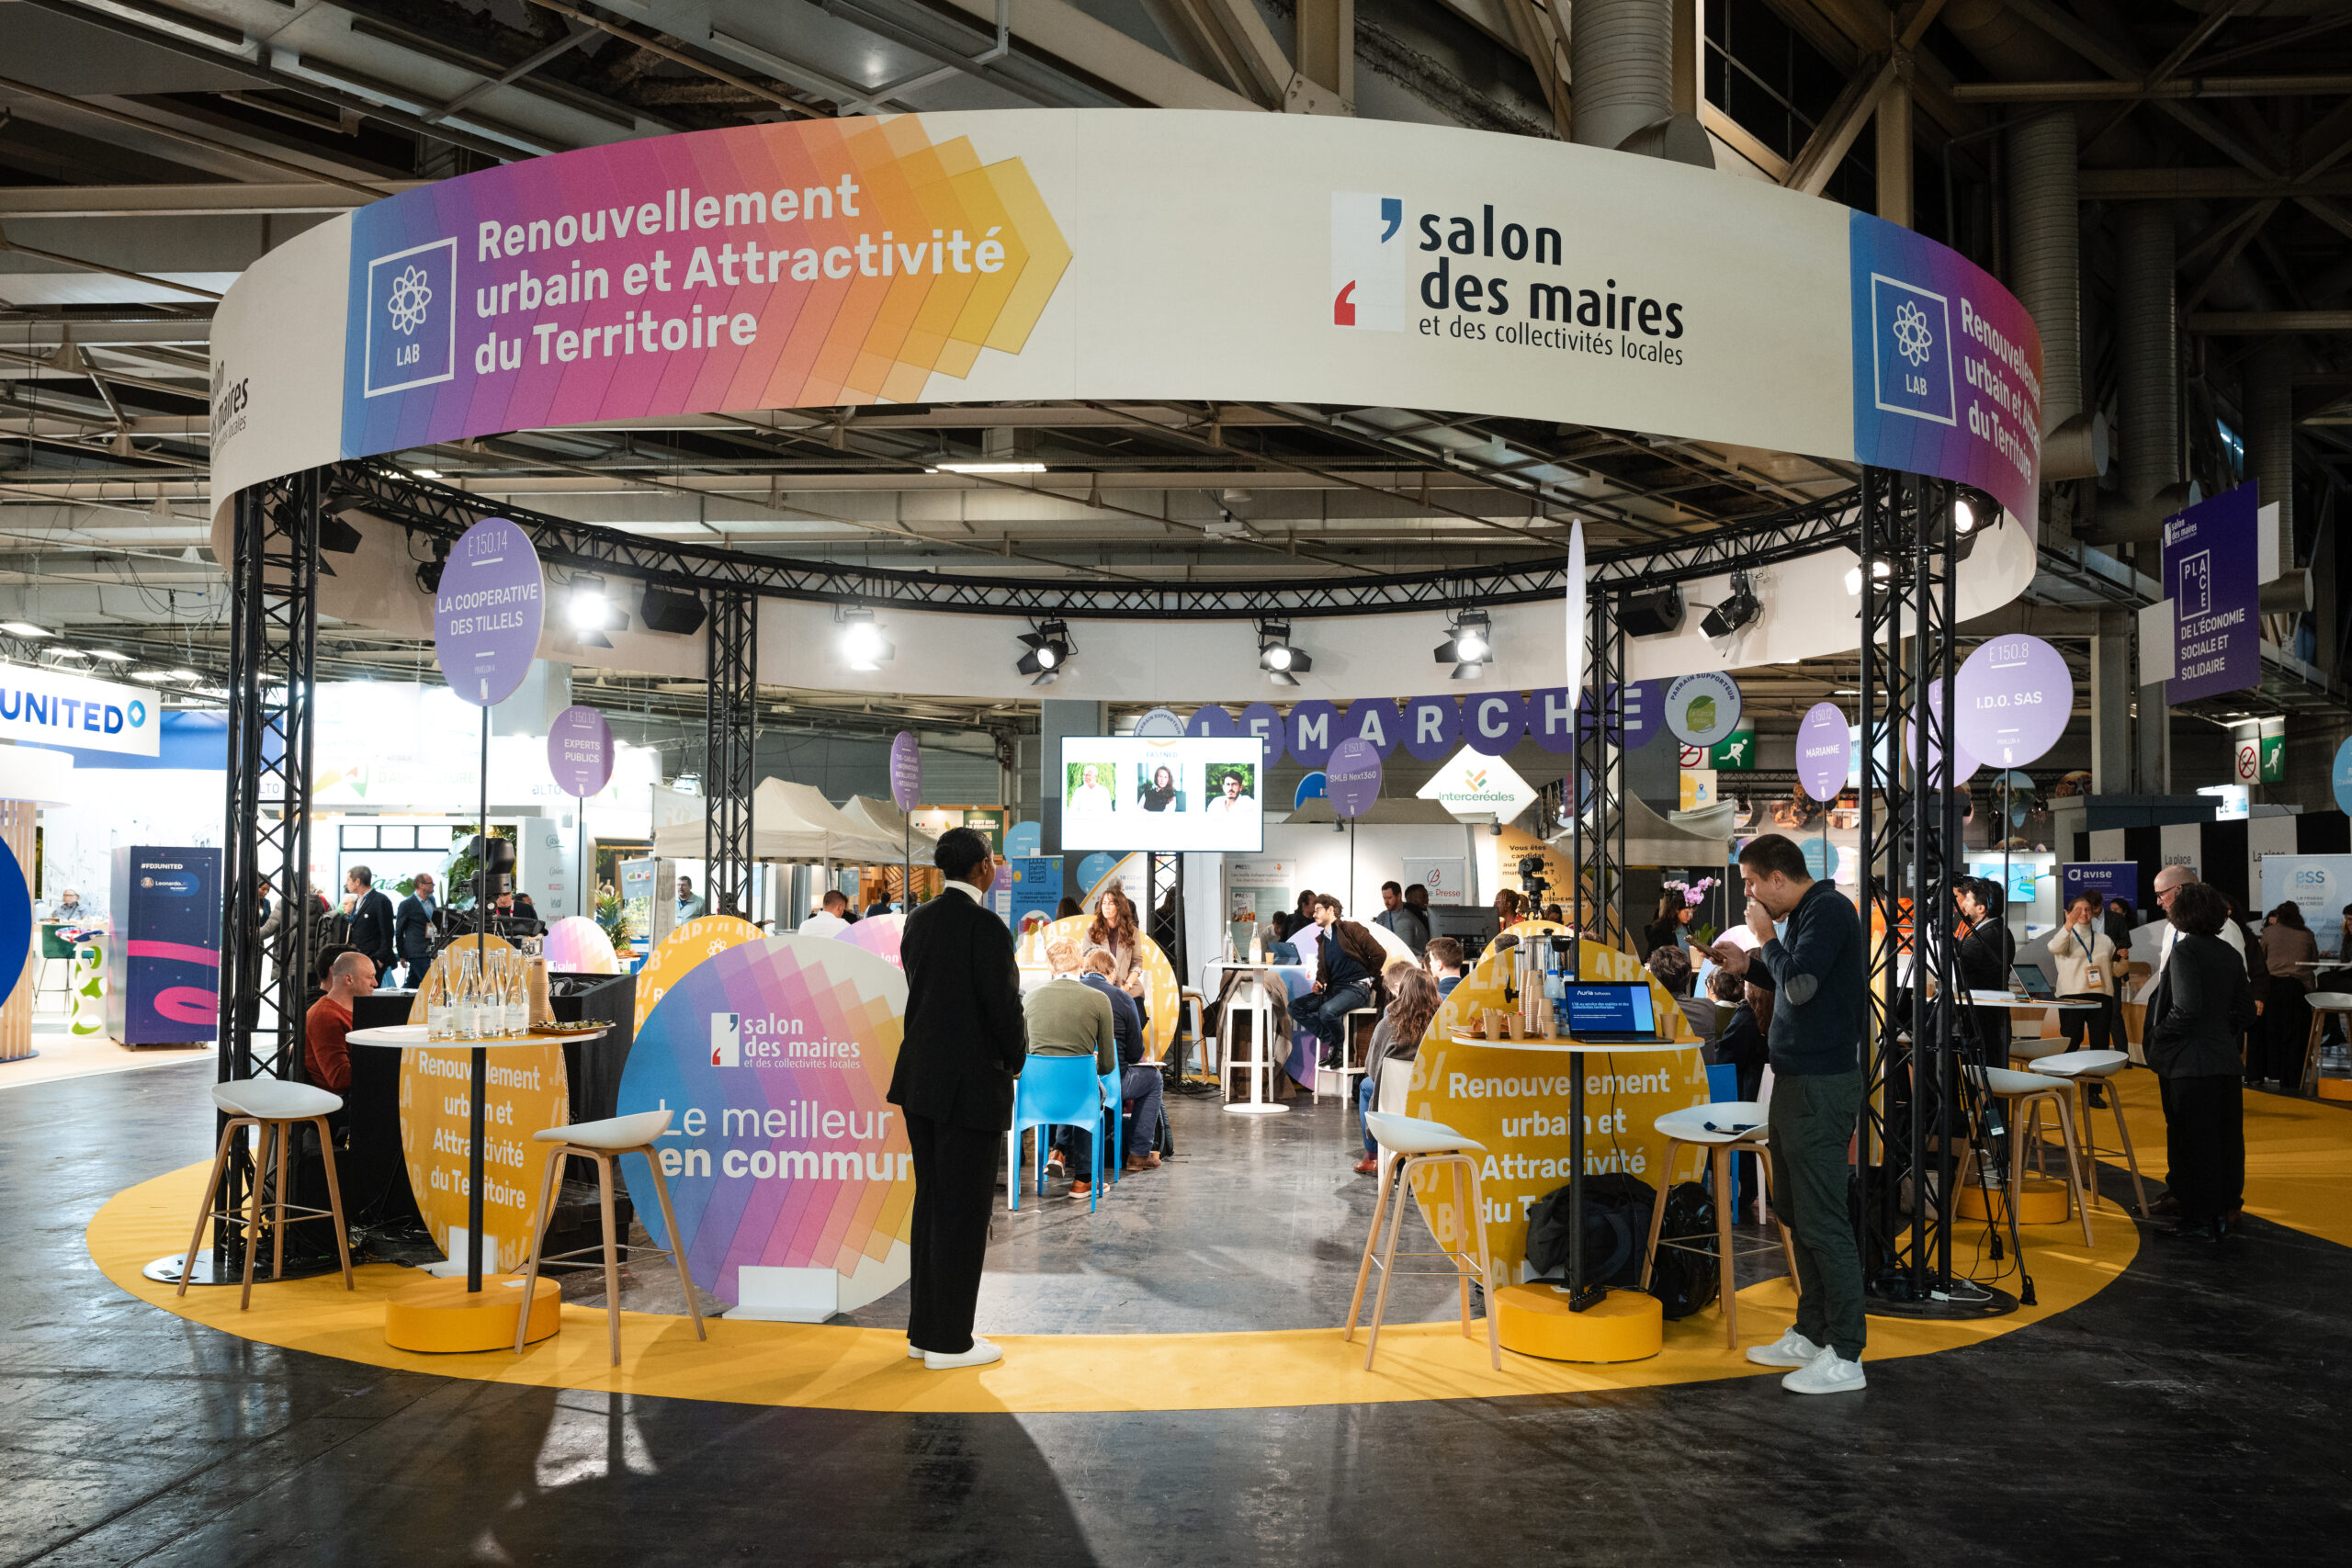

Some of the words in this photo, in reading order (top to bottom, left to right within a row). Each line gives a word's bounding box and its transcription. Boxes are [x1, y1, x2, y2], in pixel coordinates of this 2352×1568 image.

[477, 174, 859, 263] Renouvellement
[1419, 204, 1562, 265] salon
[477, 256, 610, 319] urbain
[623, 256, 672, 296] et
[683, 226, 1005, 290] Attractivité
[1420, 256, 1510, 316] des
[1530, 279, 1684, 339] maires
[475, 332, 522, 374] du
[534, 306, 758, 365] Territoire
[1419, 315, 1441, 336] et
[1450, 314, 1487, 340] des
[1496, 321, 1613, 355] collectivités
[1622, 335, 1683, 366] locales
[396, 341, 421, 367] LAB
[1905, 373, 1928, 396] LAB
[1964, 355, 2011, 412] urbain
[2012, 389, 2022, 425] et
[1968, 400, 1990, 442] du
[1992, 412, 2032, 485] Territoire
[2171, 518, 2186, 531] salon
[2171, 530, 2180, 540] des
[2181, 523, 2198, 536] maires
[468, 536, 474, 557] E
[476, 529, 508, 555] 150.14
[438, 598, 453, 614] LA
[455, 582, 538, 611] COOPERATIVE
[450, 617, 473, 636] DES
[475, 611, 524, 631] TILLELS
[2181, 626, 2192, 640] DE
[2193, 607, 2245, 637] L'ÉCONOMIE
[1989, 647, 1996, 661] E
[1998, 642, 2030, 660] 150.8
[2181, 637, 2217, 660] SOCIALE
[2217, 634, 2229, 650] ET
[2181, 657, 2225, 681] SOLIDAIRE
[1670, 674, 1695, 700] PARRAIN
[1696, 672, 1736, 701] SUPPORTEUR
[1976, 694, 2011, 709] I.D.O.
[2013, 691, 2043, 705] SAS
[564, 739, 601, 750] EXPERTS
[565, 751, 600, 763] PUBLICS
[1806, 744, 1840, 758] MARIANNE
[1329, 773, 1348, 783] SMLB
[1349, 771, 1377, 781] Next360
[2165, 854, 2173, 865] La
[2083, 871, 2112, 879] avise
[2295, 871, 2325, 884] ess
[1435, 889, 1462, 897] Presse
[557, 961, 577, 972] salon
[744, 1012, 804, 1035] salon
[744, 1035, 781, 1057] des
[788, 1036, 861, 1058] maires
[419, 1051, 540, 1091] Renouvlement
[744, 1058, 753, 1068] et
[756, 1058, 771, 1068] des
[775, 1057, 827, 1069] collectivités
[830, 1058, 861, 1070] locales
[1449, 1067, 1670, 1100] Renouveement
[496, 1100, 514, 1126] et
[659, 1099, 707, 1137] Le
[722, 1100, 894, 1139] meilleur
[1598, 1108, 1626, 1134] et
[434, 1127, 525, 1168] Attrativité
[659, 1148, 711, 1178] en
[1480, 1146, 1646, 1181] Attracivité
[431, 1165, 448, 1191] du
[452, 1169, 526, 1210] Teitoire
[1483, 1197, 1511, 1224] du
